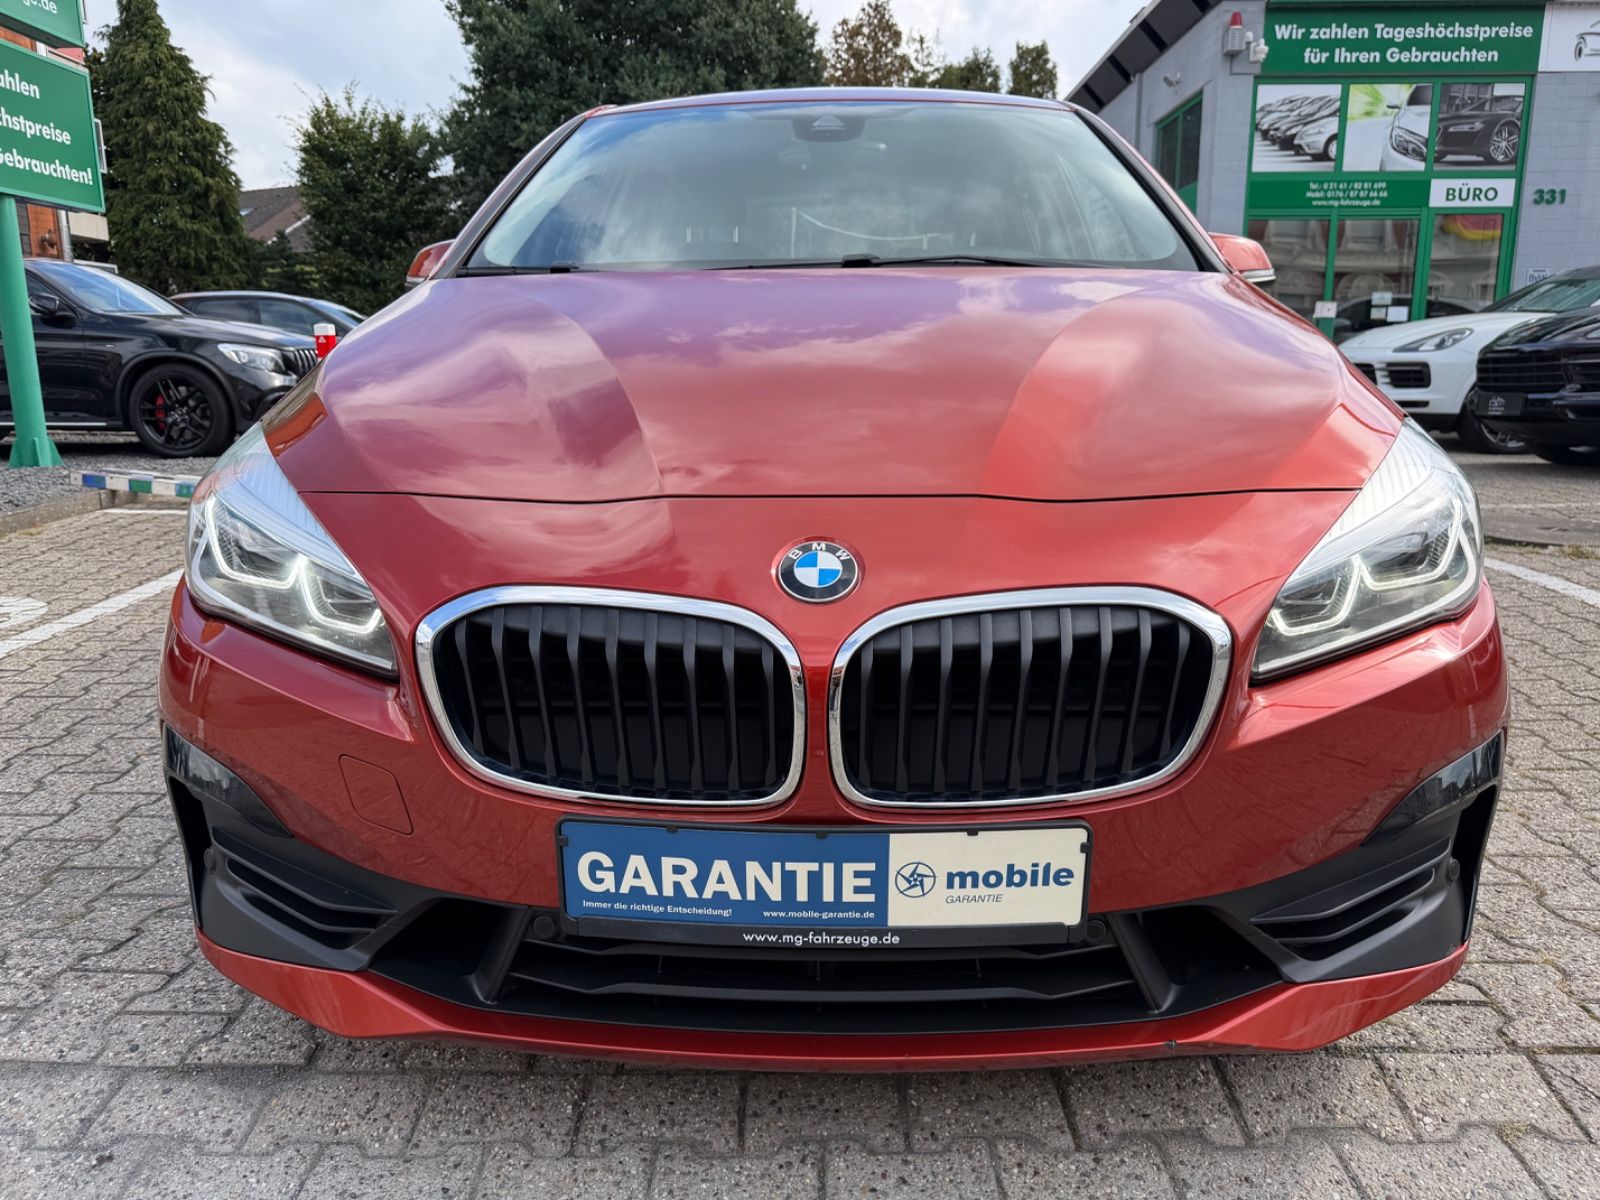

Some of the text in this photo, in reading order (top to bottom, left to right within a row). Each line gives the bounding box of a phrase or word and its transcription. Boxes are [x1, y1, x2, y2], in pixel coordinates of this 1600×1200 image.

[1274, 21, 1534, 42] Wir zahlen Tageshöchstpreise
[1304, 46, 1499, 64] für Ihren Gebrauchten
[0, 106, 72, 145] hstpreise
[1445, 182, 1499, 202] BÜRO
[1532, 188, 1567, 205] 331
[788, 542, 851, 561] BMW
[577, 851, 876, 903] GARANTIE
[946, 862, 1075, 890] mobile
[945, 893, 1004, 905] GARANTIE
[583, 900, 733, 917] Immer die richtige Entscheidung!
[762, 910, 876, 920] www.mobile-garantie.de
[743, 931, 901, 947] www.mg-fahrzeuge.de
